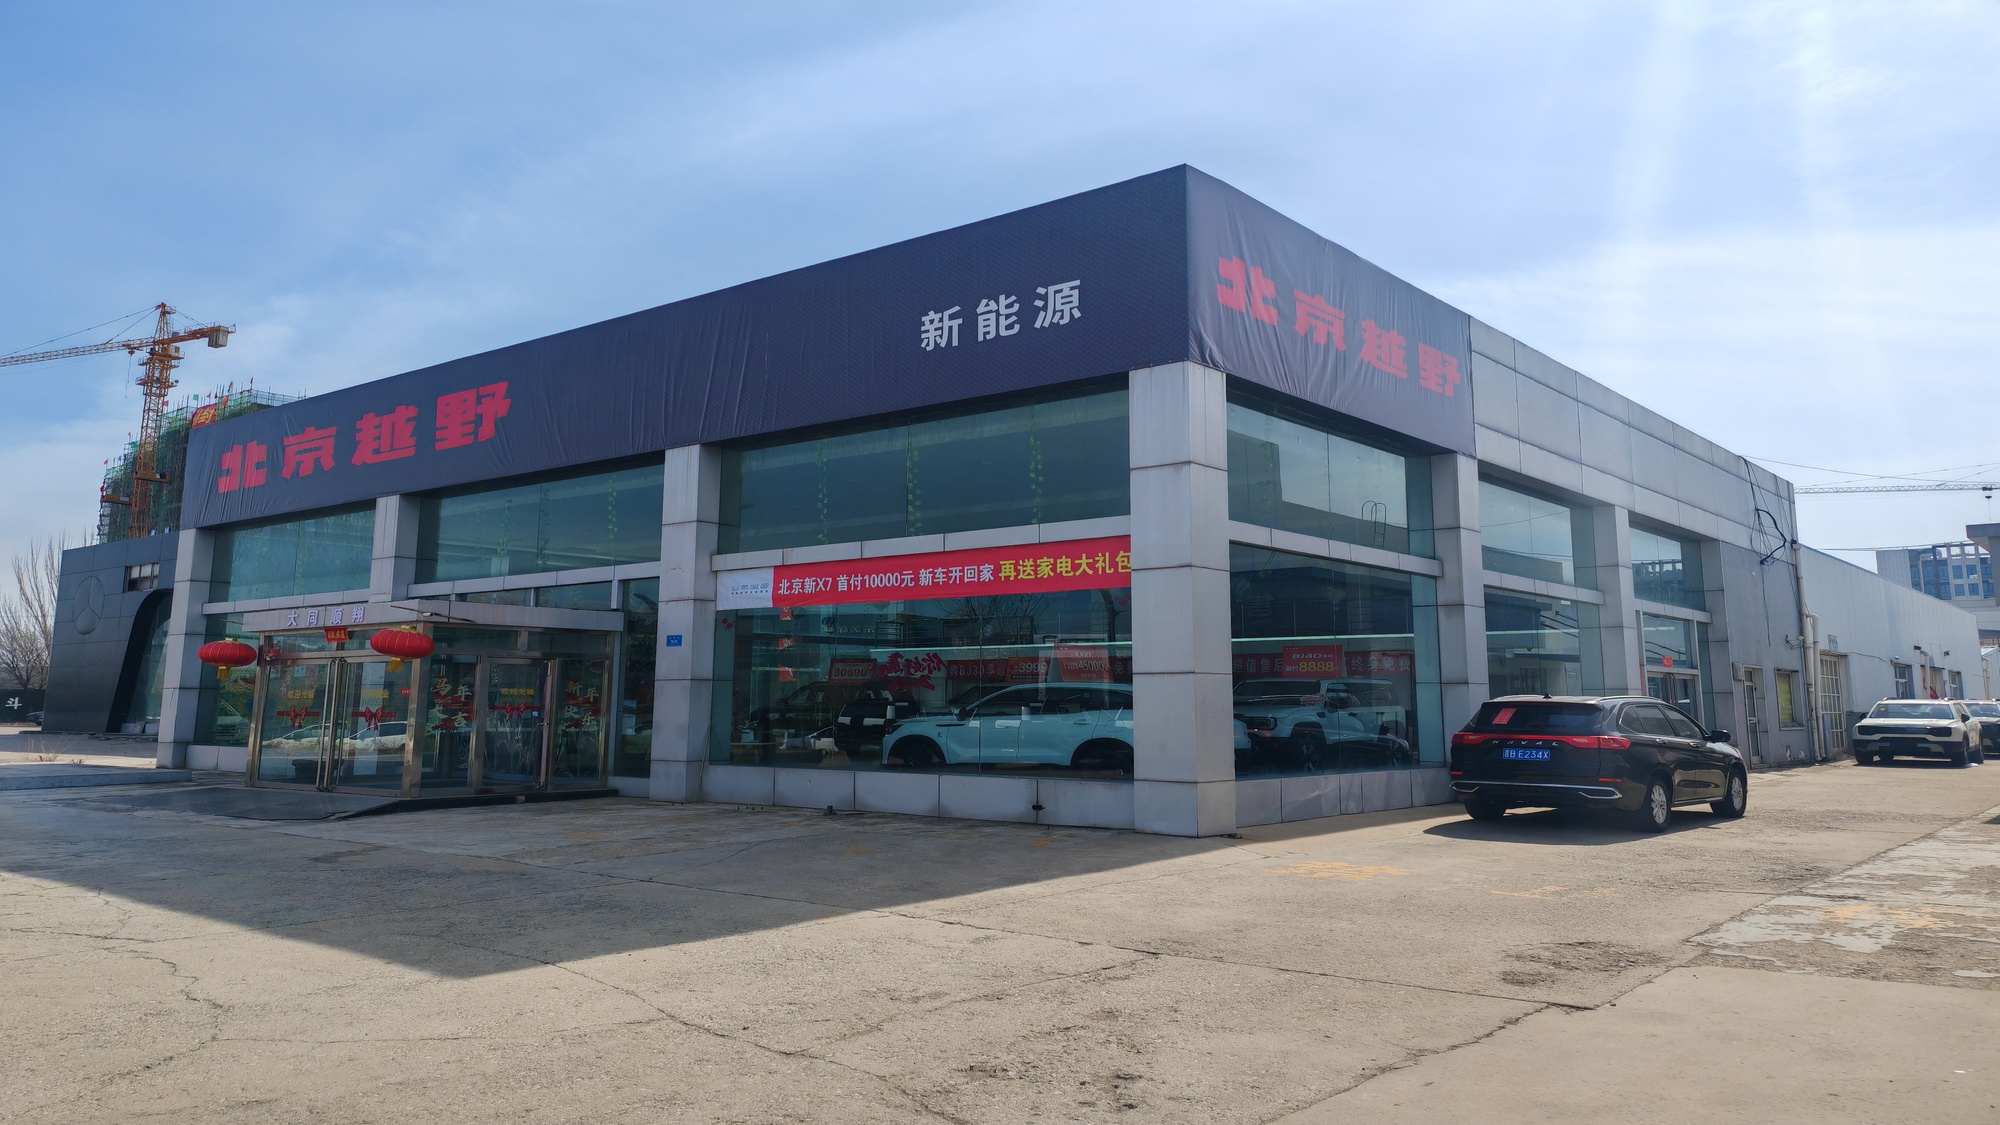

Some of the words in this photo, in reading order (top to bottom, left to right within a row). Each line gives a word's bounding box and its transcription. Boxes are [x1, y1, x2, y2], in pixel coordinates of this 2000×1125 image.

[920, 279, 1081, 351] 新能源
[1217, 256, 1461, 396] 北京越野
[217, 381, 512, 494] 北京越野
[777, 575, 834, 596] 北京新X7
[836, 570, 915, 592] 首付10000元
[918, 563, 995, 586] 新车开回家
[999, 551, 1131, 582] 再送家电大礼包
[287, 606, 366, 627] 大同顺翔
[1345, 655, 1411, 672] 终身免费
